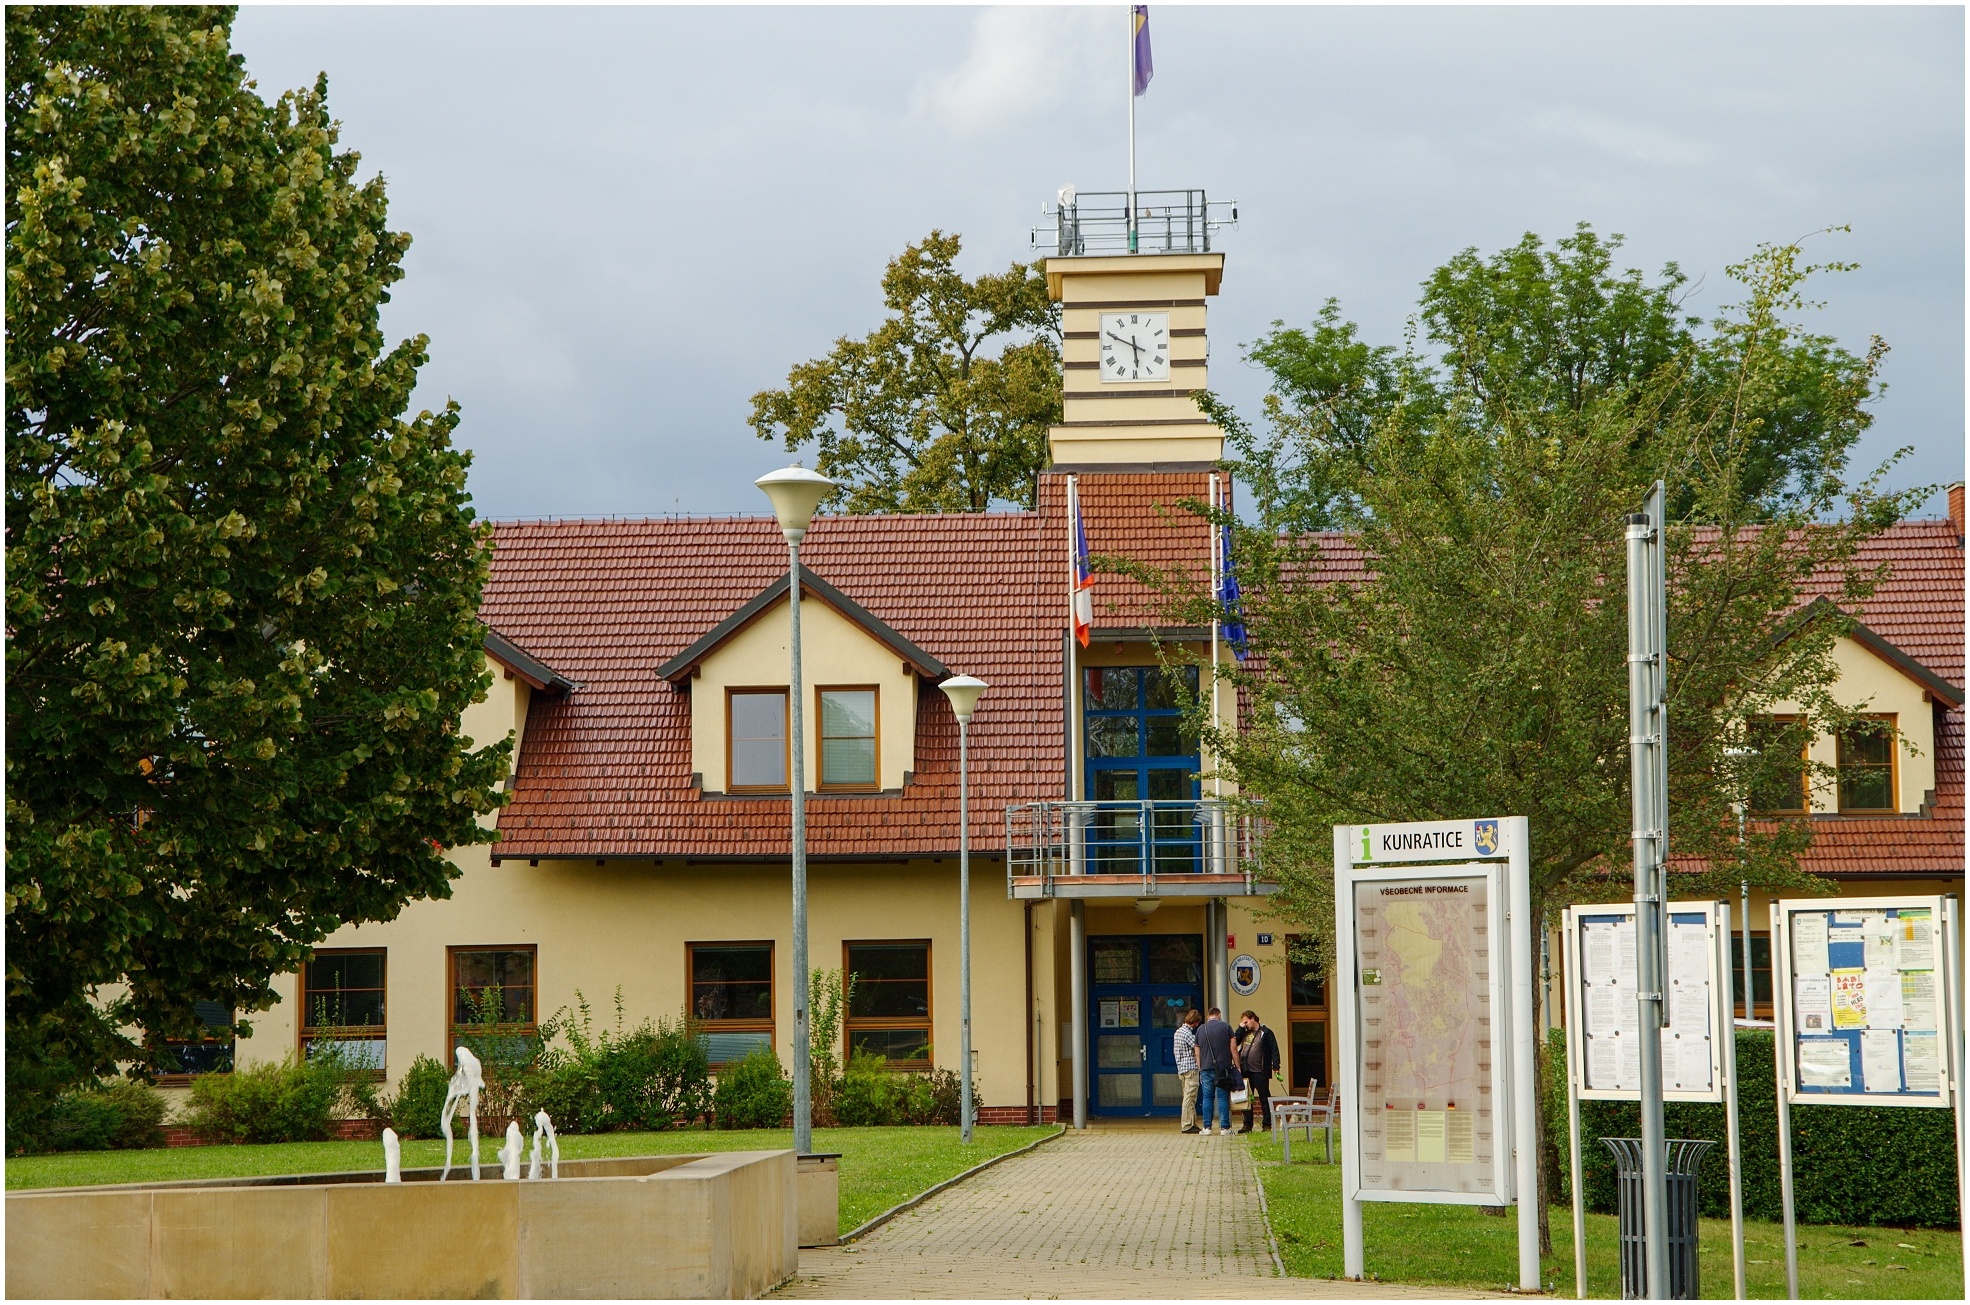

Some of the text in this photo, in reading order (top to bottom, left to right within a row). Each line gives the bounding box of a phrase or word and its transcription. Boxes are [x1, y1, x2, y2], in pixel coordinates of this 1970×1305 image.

[1383, 831, 1463, 851] KUNRATICE
[1379, 884, 1469, 896] VŠEOBECNÉ INFORMACE
